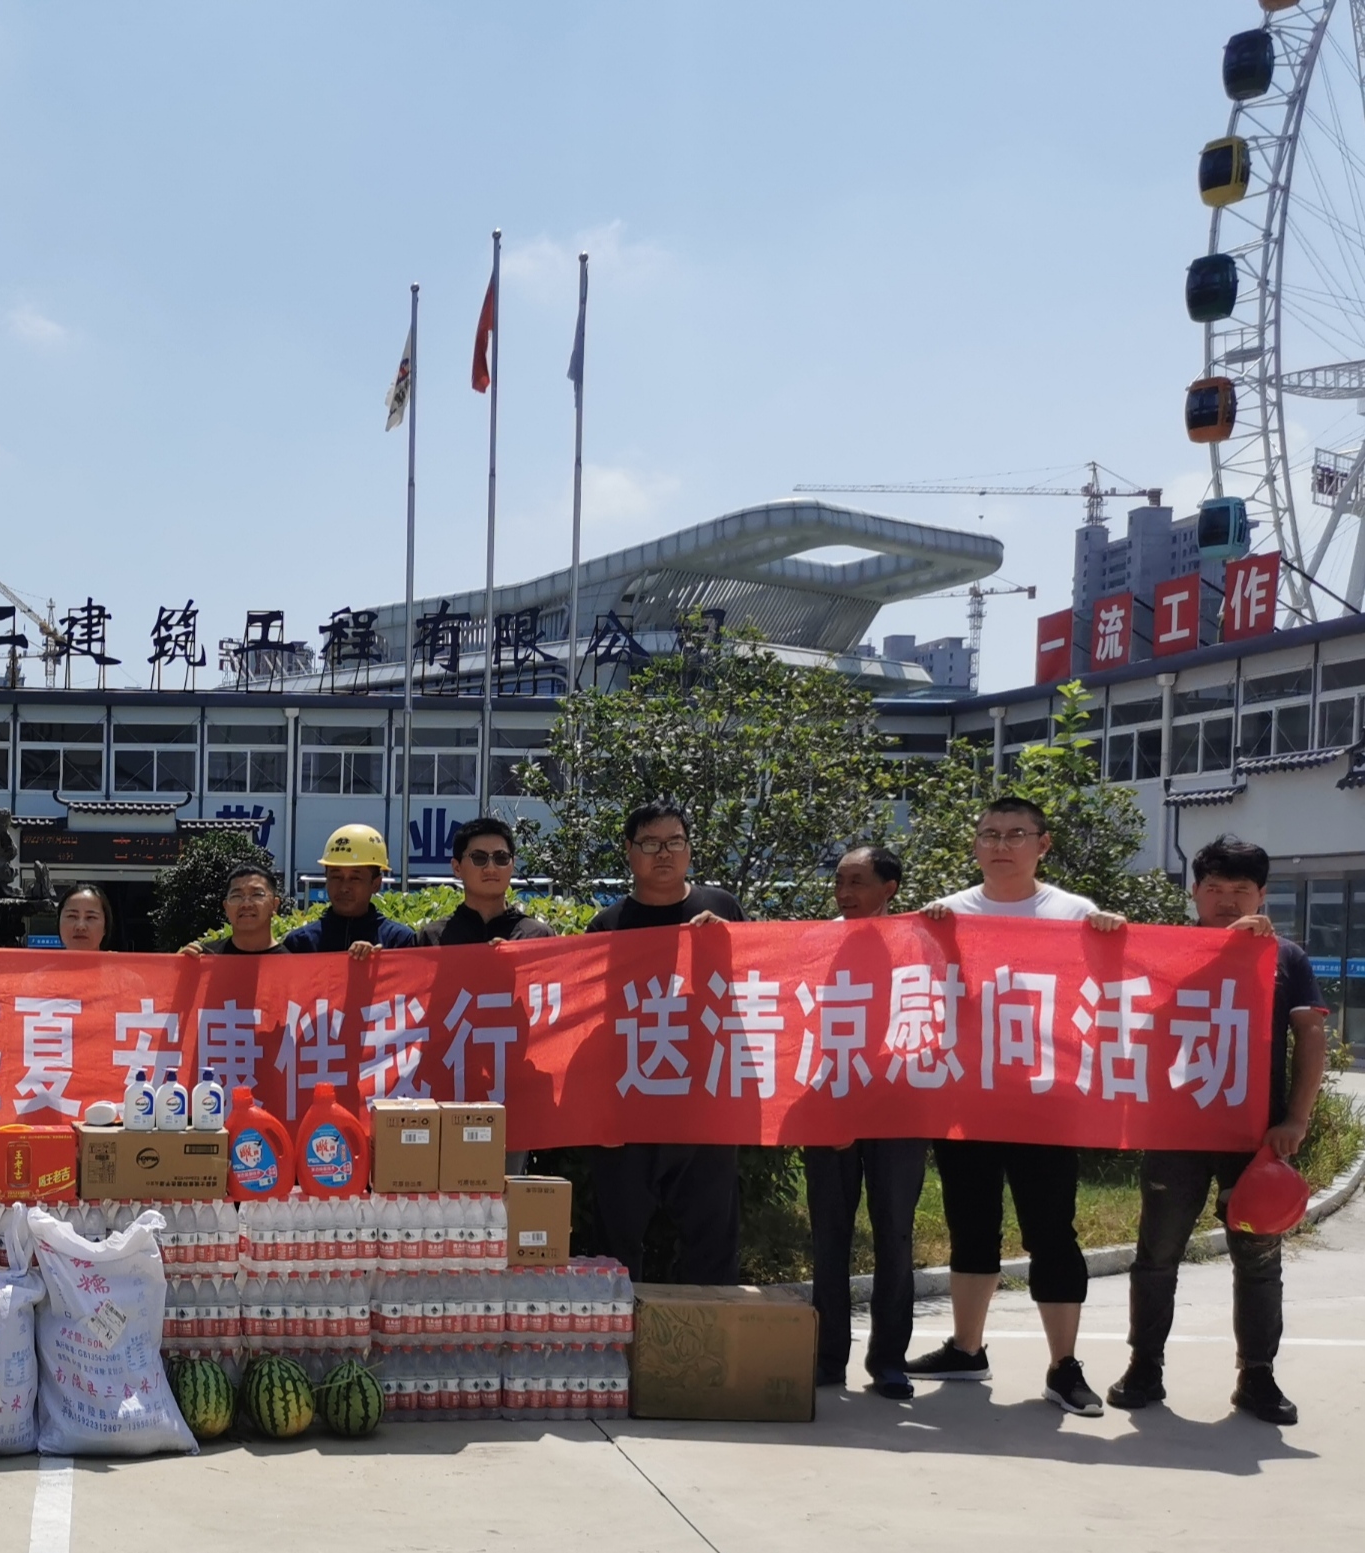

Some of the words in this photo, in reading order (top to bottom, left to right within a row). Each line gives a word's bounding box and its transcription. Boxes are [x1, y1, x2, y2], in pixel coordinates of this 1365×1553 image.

[1040, 565, 1271, 661] 一流工作
[613, 963, 1251, 1108] 送清凉慰问活动
[38, 1167, 71, 1189] 喝王老吉
